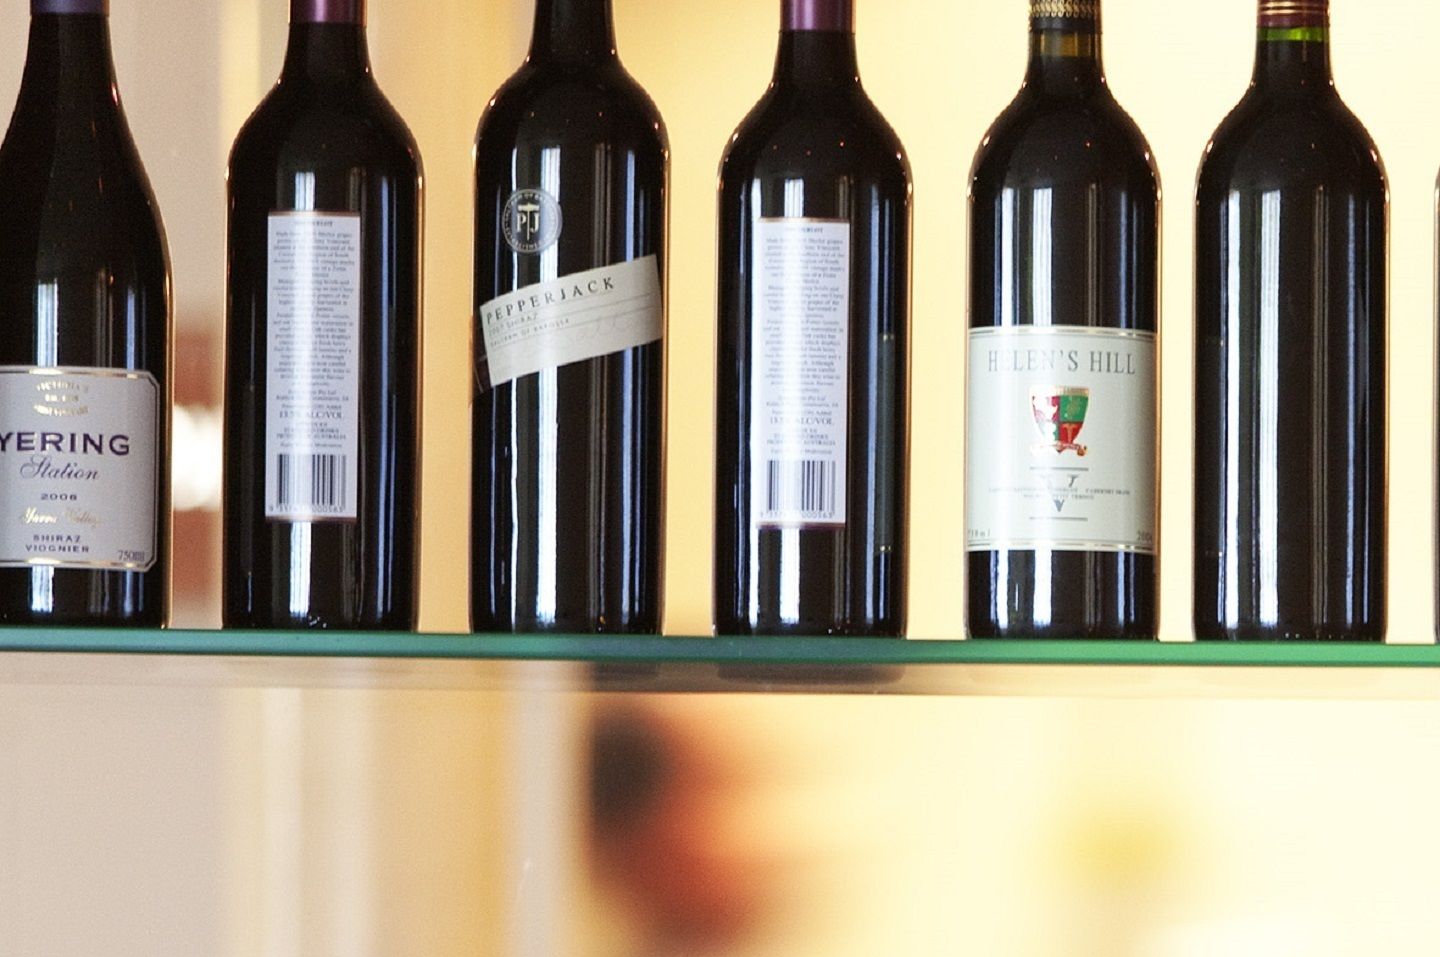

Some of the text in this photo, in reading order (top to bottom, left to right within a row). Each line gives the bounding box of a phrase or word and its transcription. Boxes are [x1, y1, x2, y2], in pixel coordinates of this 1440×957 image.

[485, 276, 614, 325] PEPPERJACK
[988, 350, 1135, 375] HLEN'S HILL
[0, 432, 130, 456] YERING
[20, 455, 99, 480] Station
[25, 544, 89, 553] VIOGNIER
[33, 534, 81, 543] SHIRAZ
